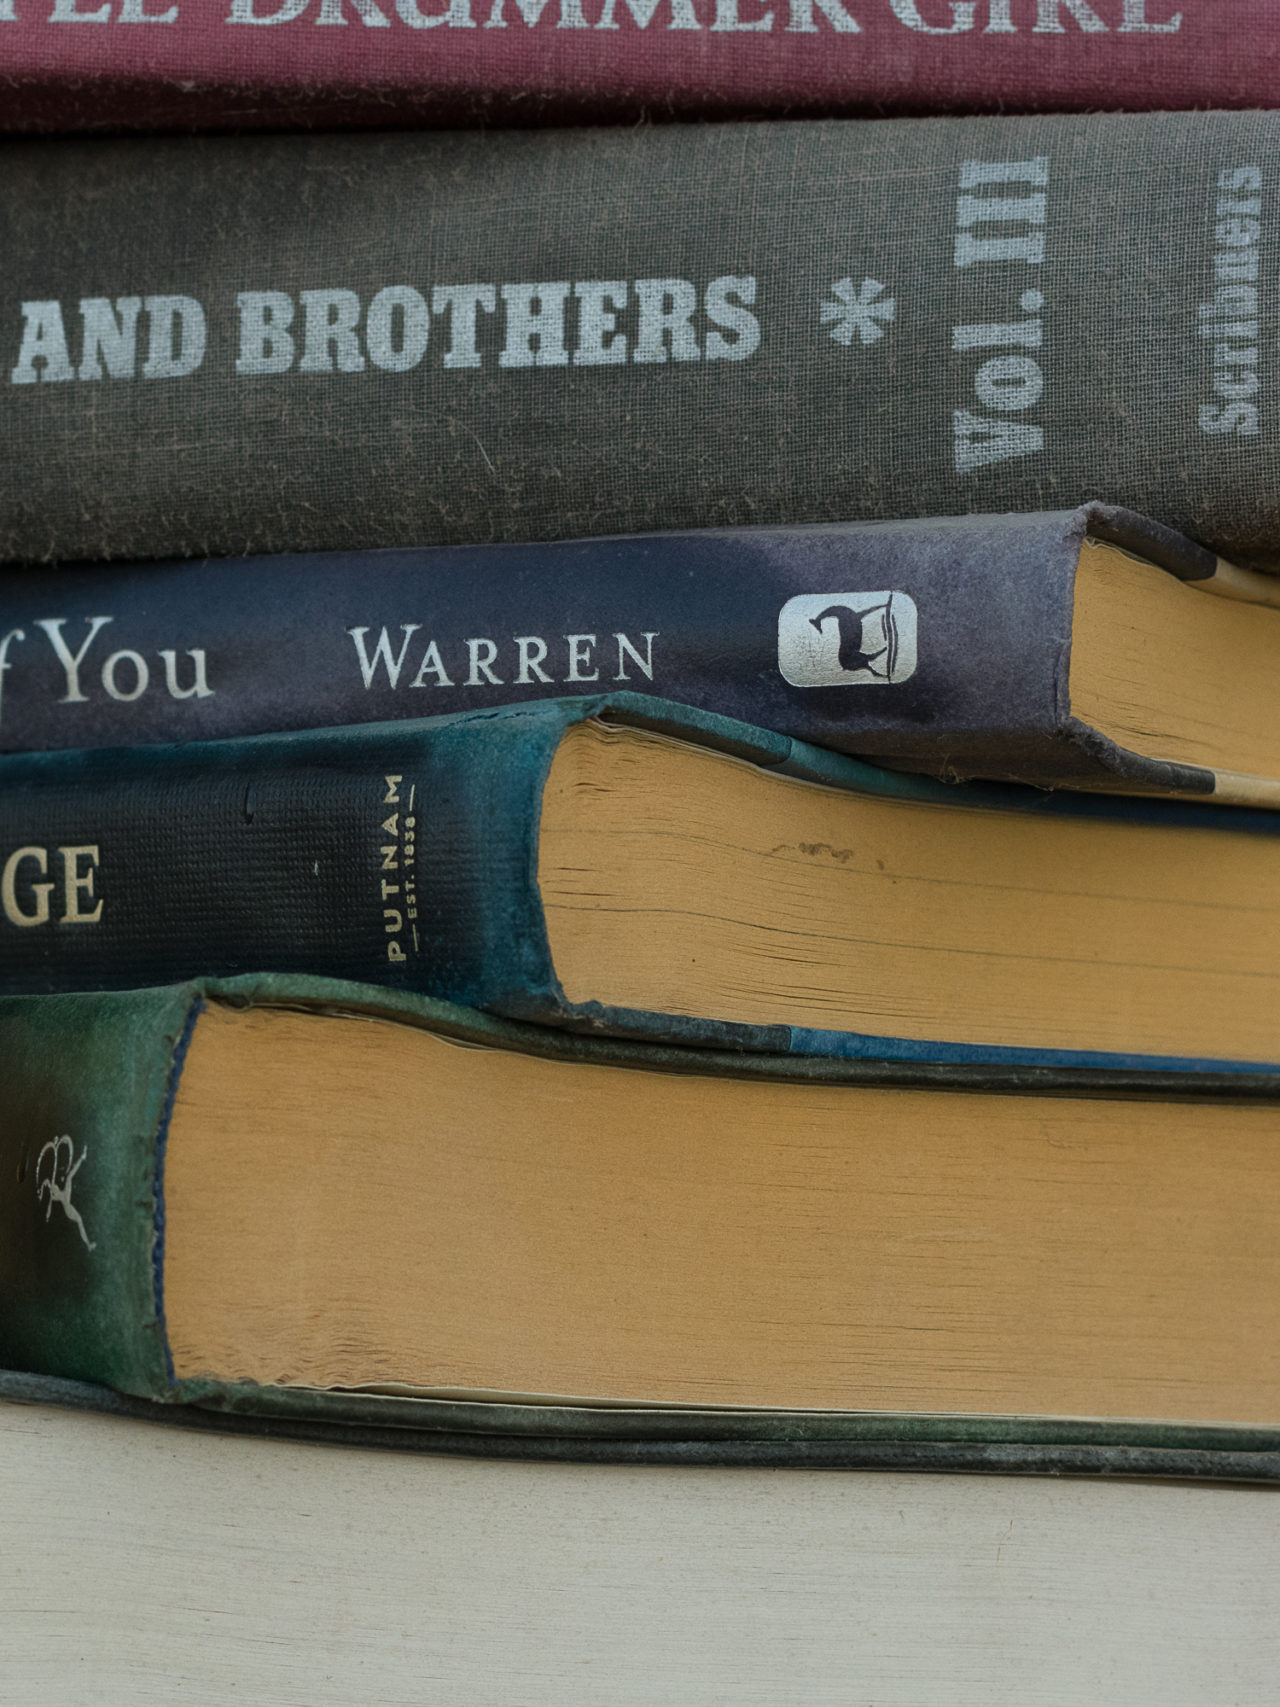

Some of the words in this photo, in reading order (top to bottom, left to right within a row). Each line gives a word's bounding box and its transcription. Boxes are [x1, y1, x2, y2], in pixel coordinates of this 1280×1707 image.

[953, 155, 1049, 267] III
[11, 295, 207, 384] AND
[235, 275, 761, 375] BROTHERS
[1198, 162, 1263, 436] Scribners
[951, 287, 1046, 474] Vol.
[39, 616, 215, 702] You
[348, 624, 658, 689] WARREN
[380, 775, 407, 962] PUTNAM
[404, 815, 417, 867] 1838
[406, 874, 418, 920] EST.
